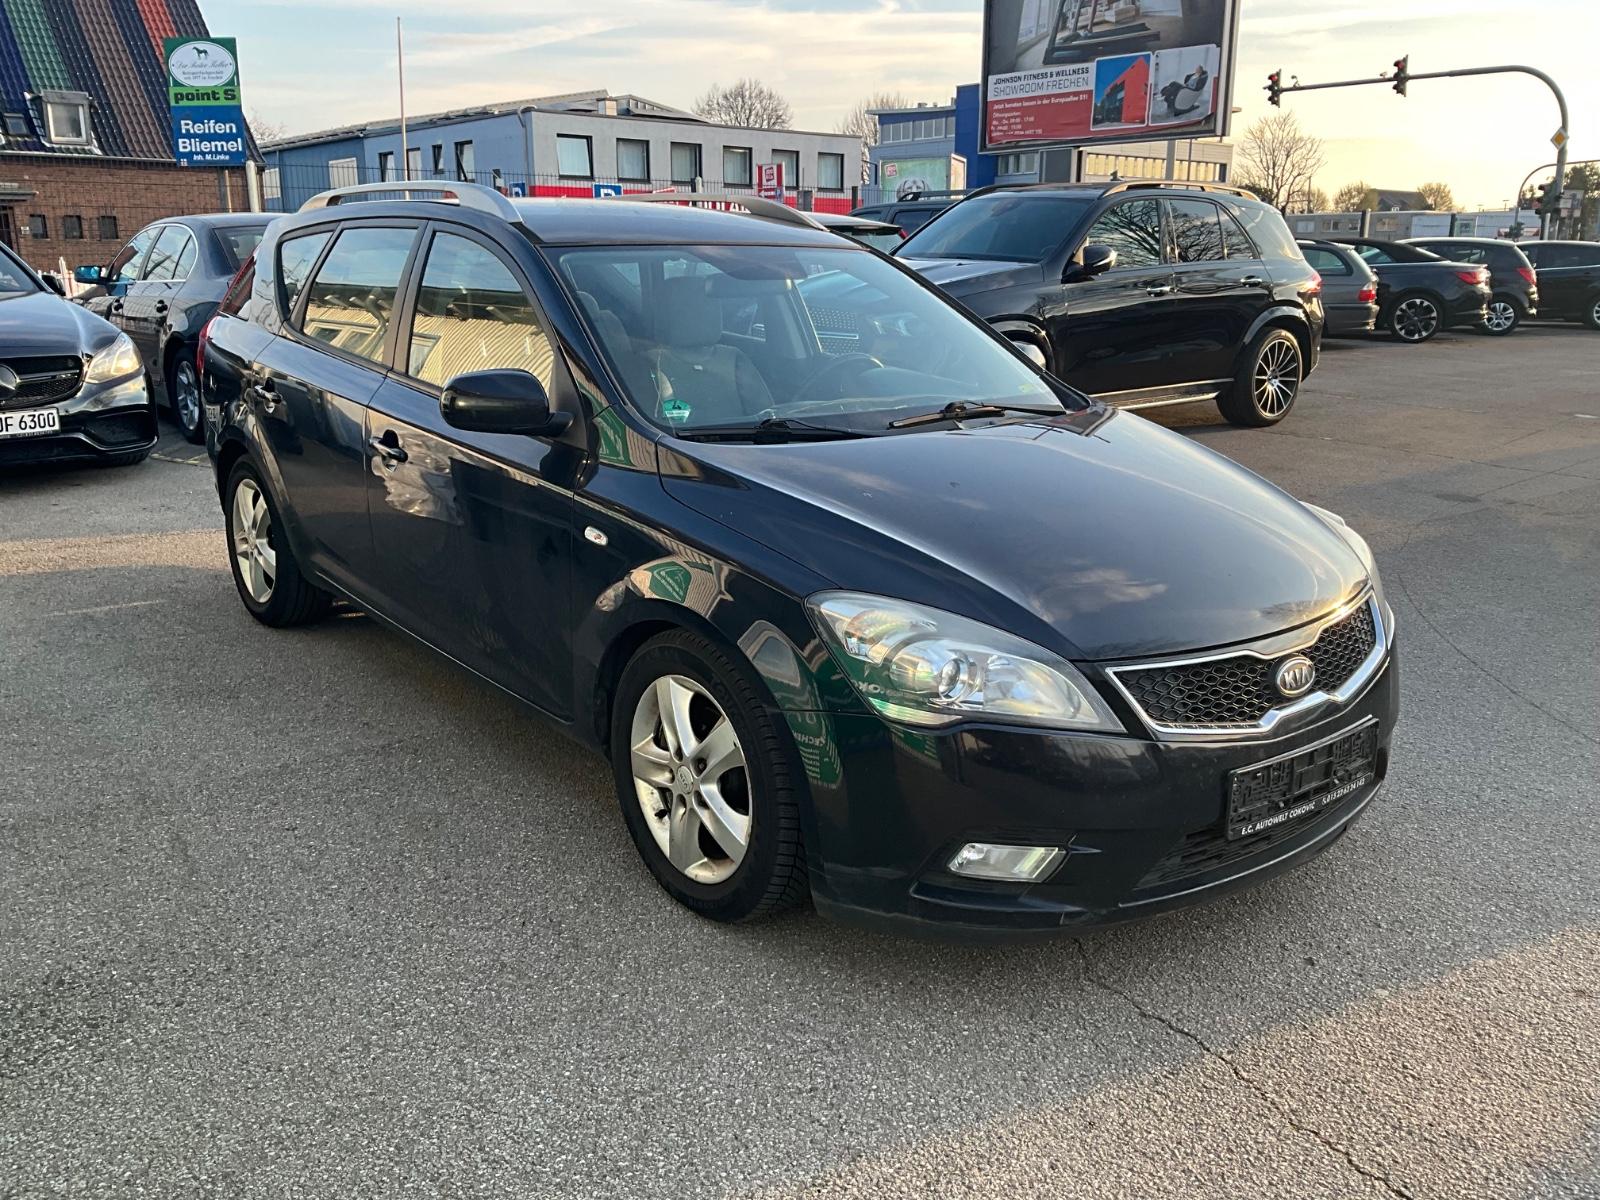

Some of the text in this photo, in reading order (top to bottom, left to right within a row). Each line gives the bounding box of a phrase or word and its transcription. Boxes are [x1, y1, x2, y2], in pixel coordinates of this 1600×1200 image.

[993, 76, 1022, 86] JOHNSON
[1023, 71, 1048, 82] FITNESS
[1055, 67, 1089, 77] WELLNESS
[174, 88, 237, 104] point S
[993, 76, 1089, 97] SHOWROOM FRECHEN
[180, 119, 237, 134] Reifen
[178, 138, 243, 153] Bliemel
[19, 412, 56, 431] 6300
[1283, 666, 1311, 690] KIA
[1241, 824, 1255, 836] E.C.
[1255, 812, 1289, 831] AUTOWELT
